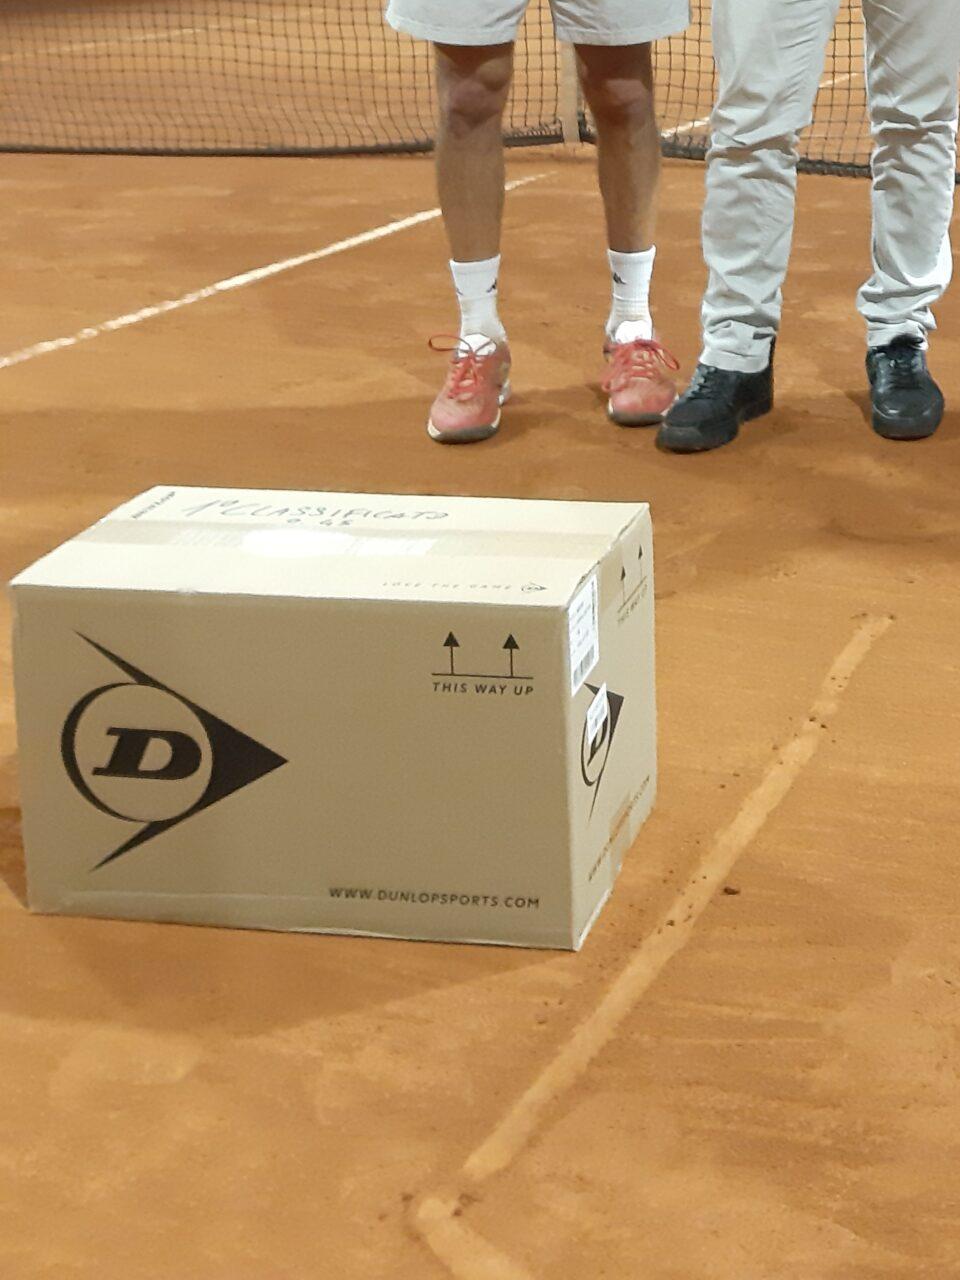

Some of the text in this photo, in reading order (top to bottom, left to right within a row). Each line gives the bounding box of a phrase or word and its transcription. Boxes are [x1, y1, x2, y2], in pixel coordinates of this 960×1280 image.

[432, 681, 535, 697] THIS WAY UP
[91, 726, 203, 781] D
